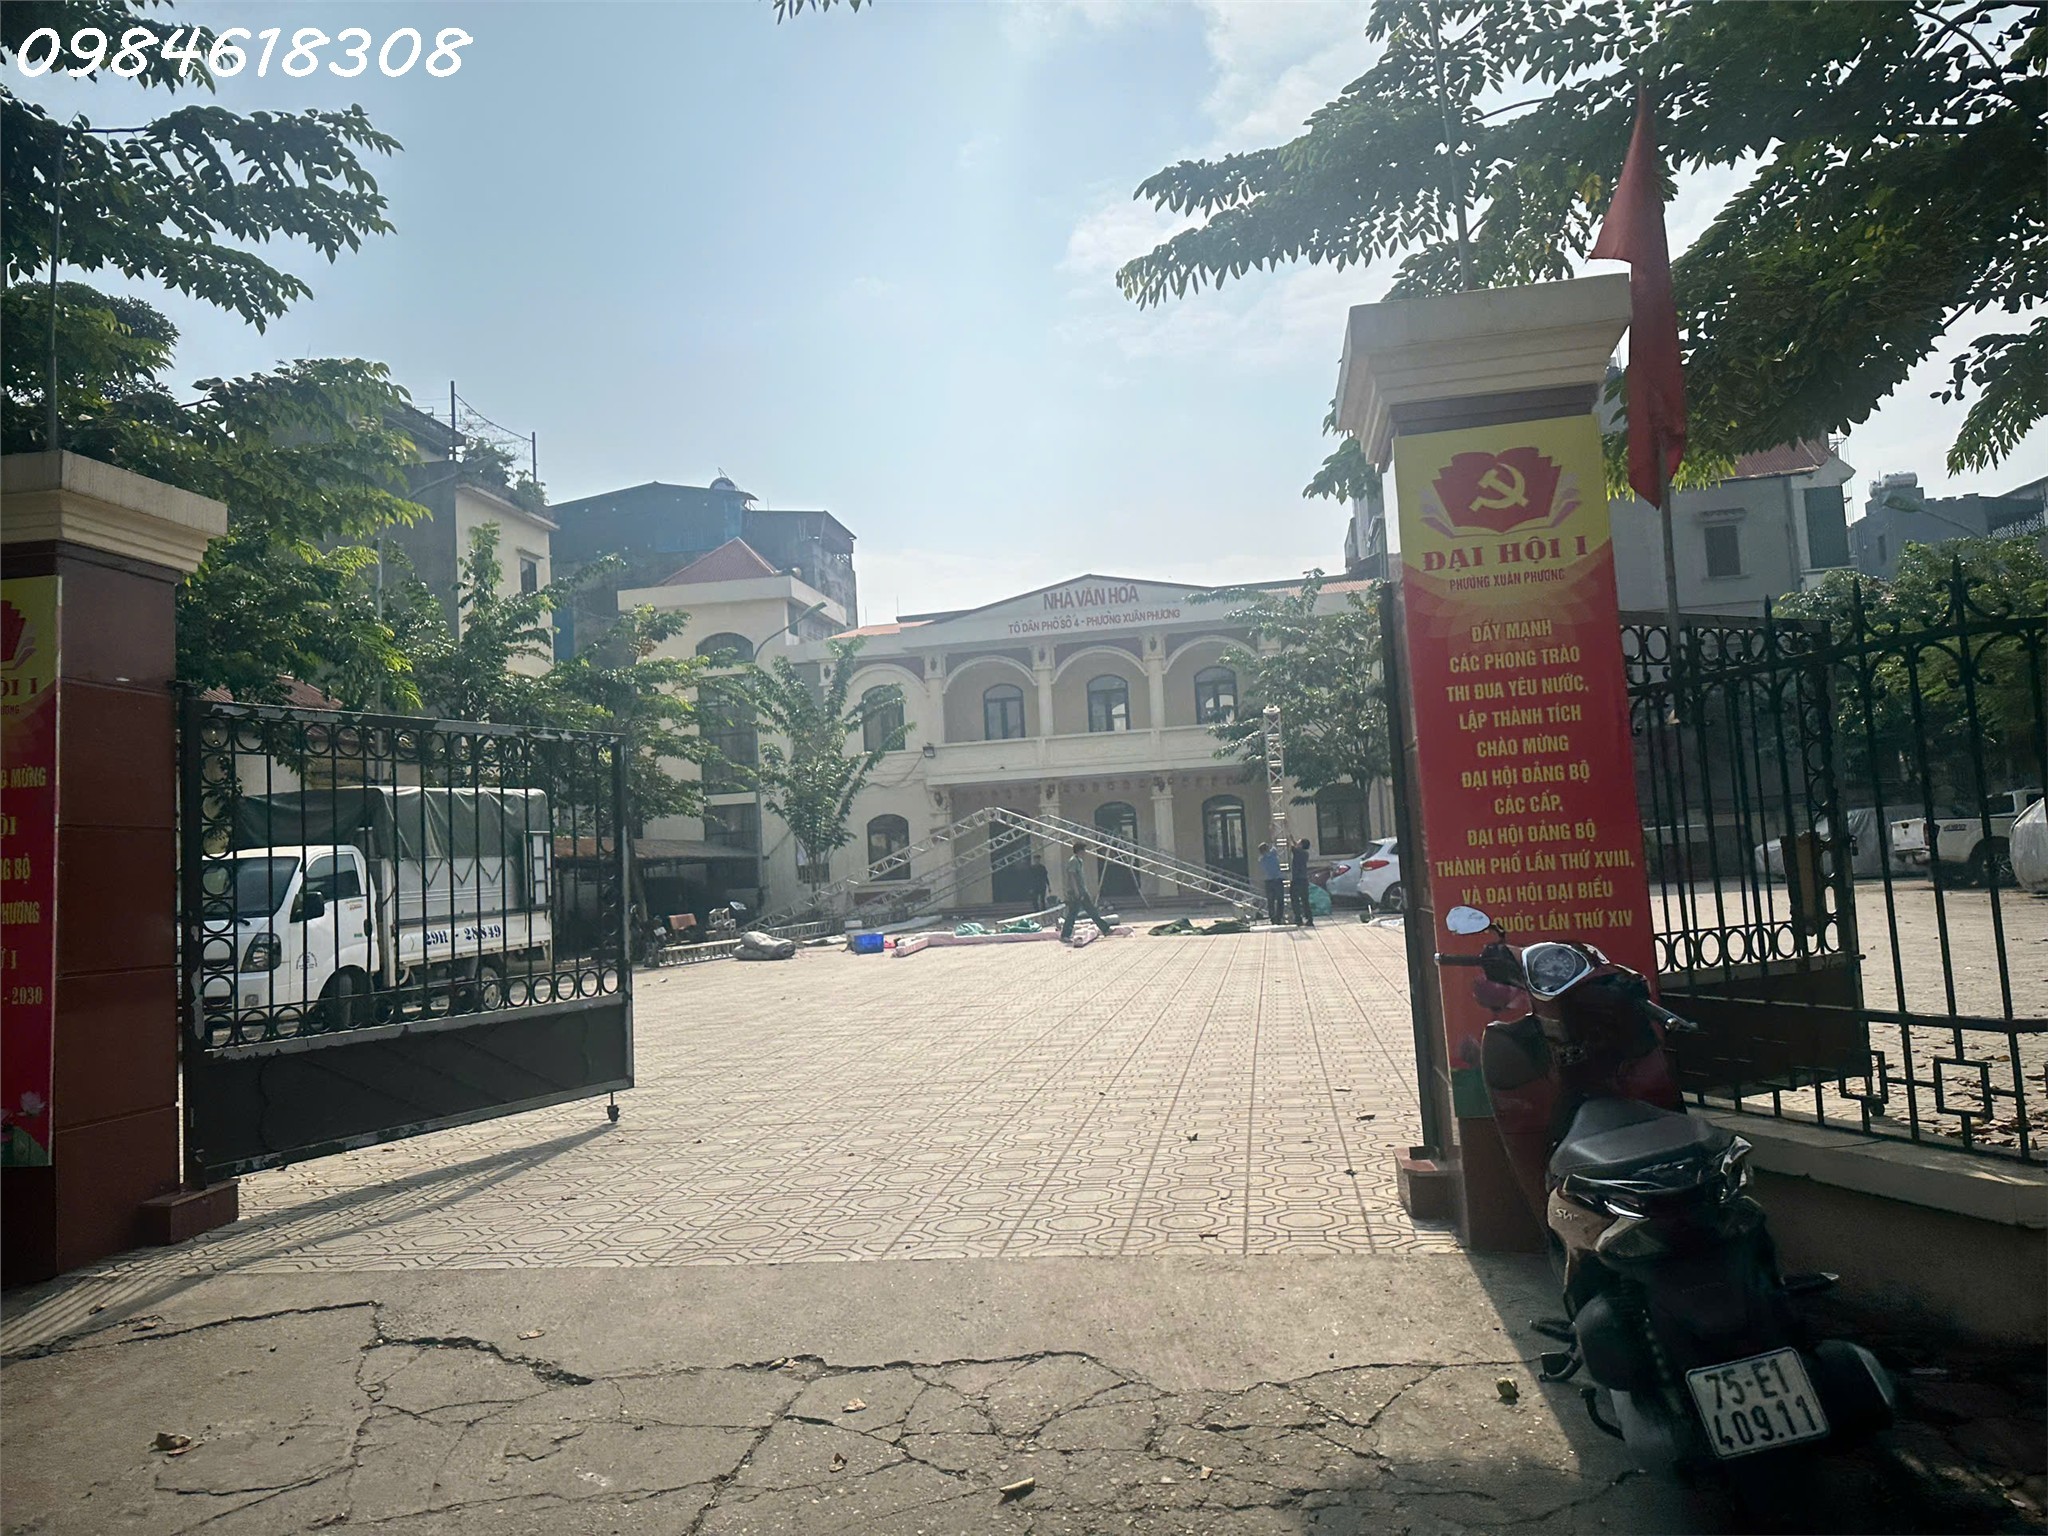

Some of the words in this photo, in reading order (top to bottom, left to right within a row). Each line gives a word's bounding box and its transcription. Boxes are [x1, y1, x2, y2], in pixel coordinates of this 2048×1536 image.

[1422, 547, 1484, 573] ĐẠI
[1498, 536, 1560, 564] HỘI
[1575, 536, 1588, 556] I
[1044, 588, 1074, 610] NHÀ
[1075, 587, 1105, 607] VĂN
[1022, 618, 1040, 633] DÂN
[1074, 619, 1080, 627] 4
[1123, 608, 1146, 623] XUÂN
[1505, 619, 1552, 642] MẠNH
[1450, 652, 1480, 674] CÁC
[1485, 651, 1537, 671] PHONG
[1540, 644, 1580, 665] TRÀO
[1446, 685, 1470, 702] THI
[1474, 682, 1504, 700] ĐUA
[1508, 677, 1538, 696] YÊU
[1459, 710, 1487, 733] LẬP
[1492, 706, 1542, 728] THÀNH
[1547, 702, 1582, 724] TÍCH
[1477, 736, 1518, 758] CHÀO
[1523, 733, 1569, 754] MỪNG
[1461, 770, 1488, 791] ĐẠI
[1492, 767, 1518, 789] HỘI
[1521, 761, 1565, 784] ĐẢNG
[1569, 760, 1590, 783] BỘ
[1495, 794, 1525, 815] CÁC
[1467, 828, 1493, 849] ĐẠI
[1498, 825, 1524, 847] HỘI
[1528, 820, 1571, 842] ĐẢNG
[1575, 819, 1596, 842] BỘ
[1436, 855, 1486, 878] THÀNH
[1490, 851, 1521, 874] PHỐ
[1525, 849, 1556, 872] LẦN
[1560, 849, 1590, 869] THỨ
[1462, 884, 1482, 906] VÀ
[1486, 885, 1512, 907] ĐẠI
[1517, 882, 1543, 905] HỘI
[1547, 884, 1573, 904] ĐẠI
[1578, 876, 1613, 898] BIỂU
[1539, 908, 1570, 931] LẦN
[1574, 908, 1604, 929] THỨ
[1608, 909, 1633, 929] XIV
[11, 986, 43, 1005] 2030
[1704, 1358, 1790, 1410] 75-E1
[1713, 1394, 1817, 1450] 409.11
